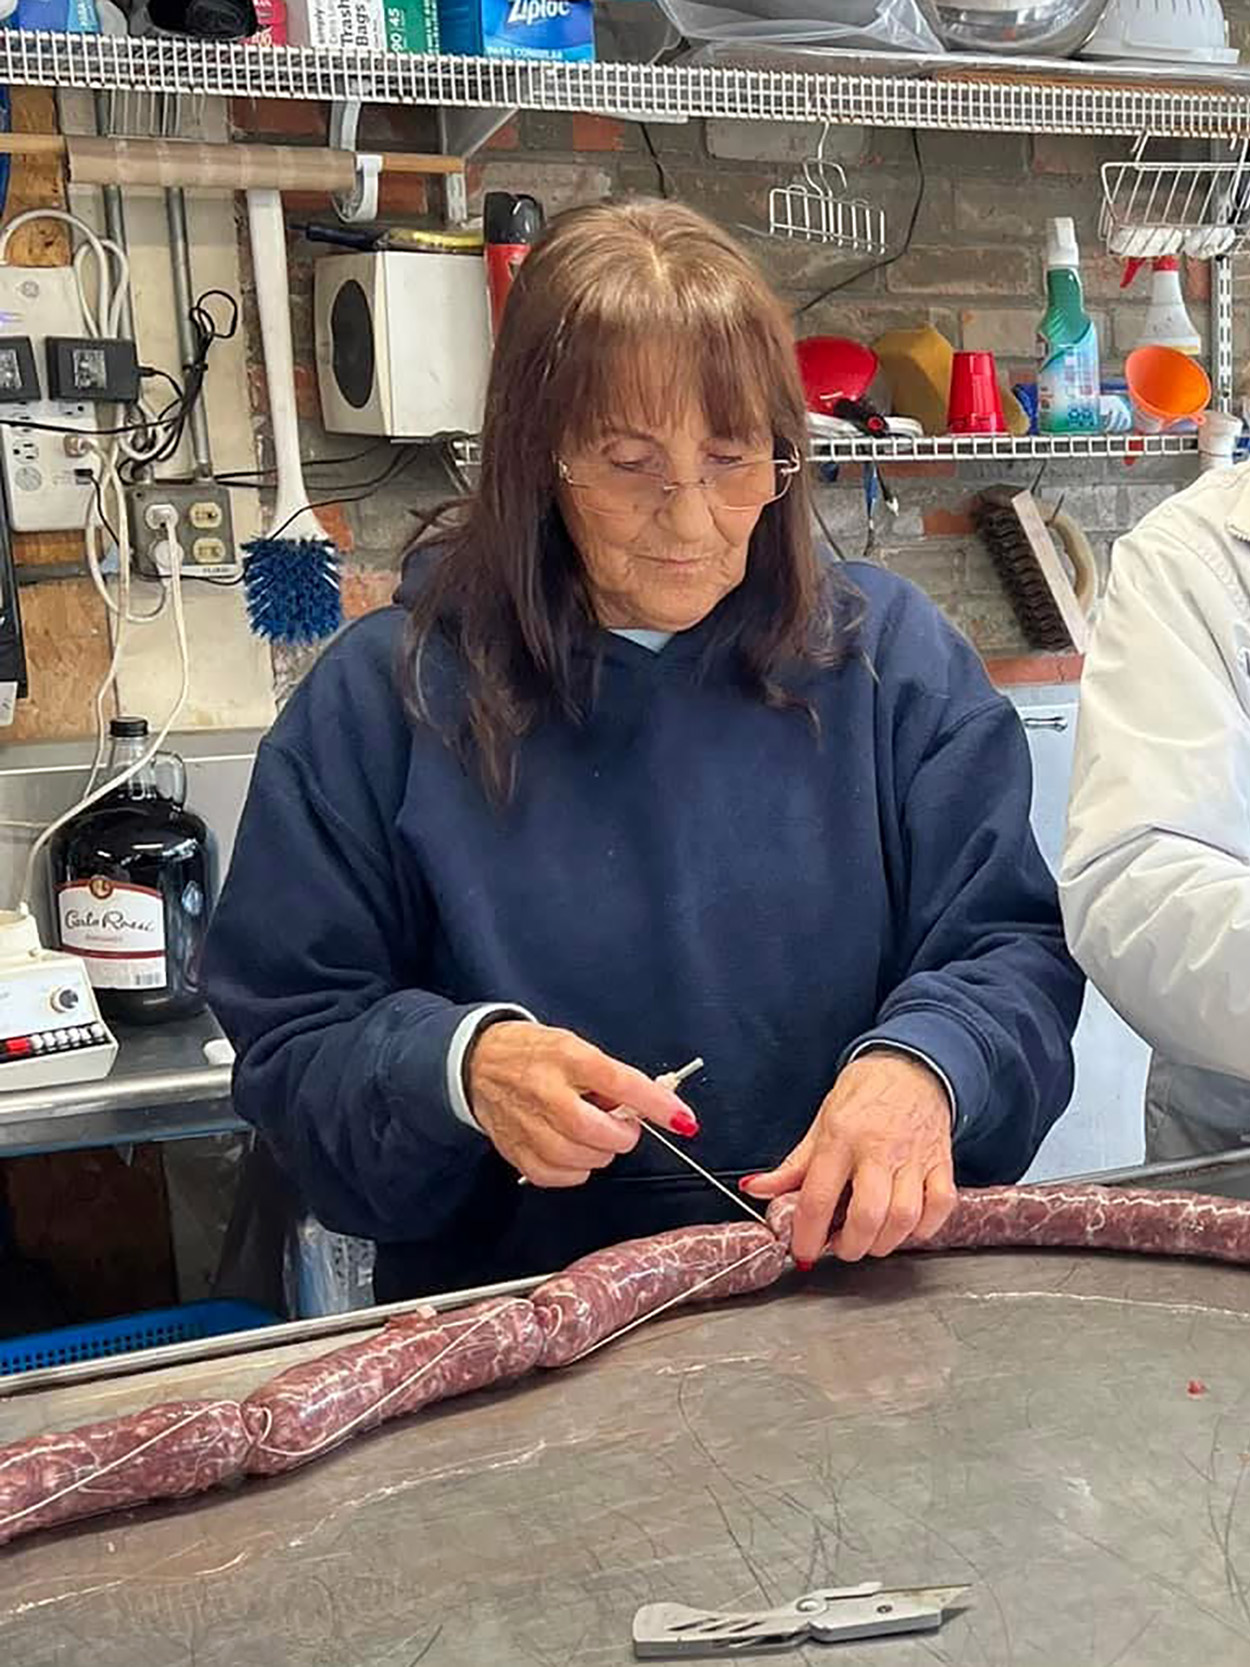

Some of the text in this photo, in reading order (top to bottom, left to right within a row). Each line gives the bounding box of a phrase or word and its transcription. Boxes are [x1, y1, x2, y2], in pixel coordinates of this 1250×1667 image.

[337, 0, 354, 47] Trash
[387, 7, 401, 27] 45
[507, 0, 571, 25] Ziploc
[355, 4, 371, 47] Bags
[65, 909, 155, 932] Carlo Rossi
